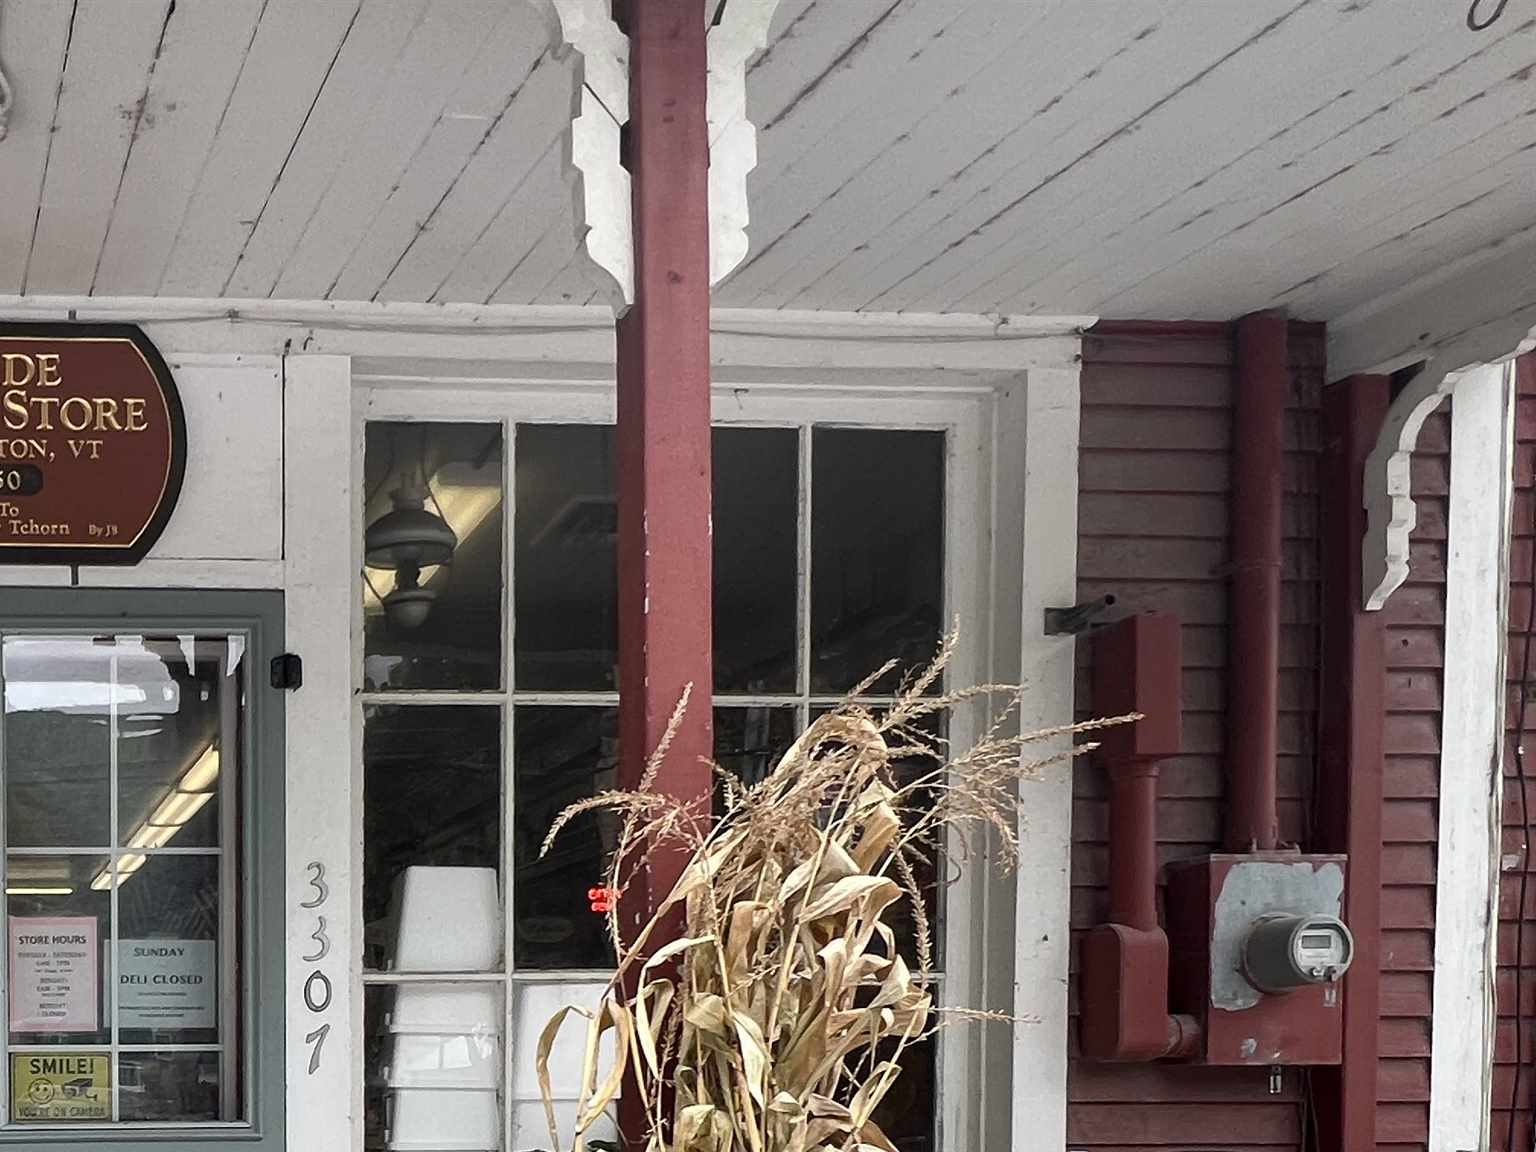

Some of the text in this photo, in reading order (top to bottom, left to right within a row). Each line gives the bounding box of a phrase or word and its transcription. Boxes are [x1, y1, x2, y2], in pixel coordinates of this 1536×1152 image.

[3, 389, 149, 432] STORE
[68, 439, 104, 459] VT
[9, 520, 71, 536] Tchorn
[18, 935, 87, 945] STORE HOURS
[133, 947, 185, 957] SUNDAY
[120, 974, 203, 985] DELI CLOSED
[29, 1058, 95, 1075] SMILE!
